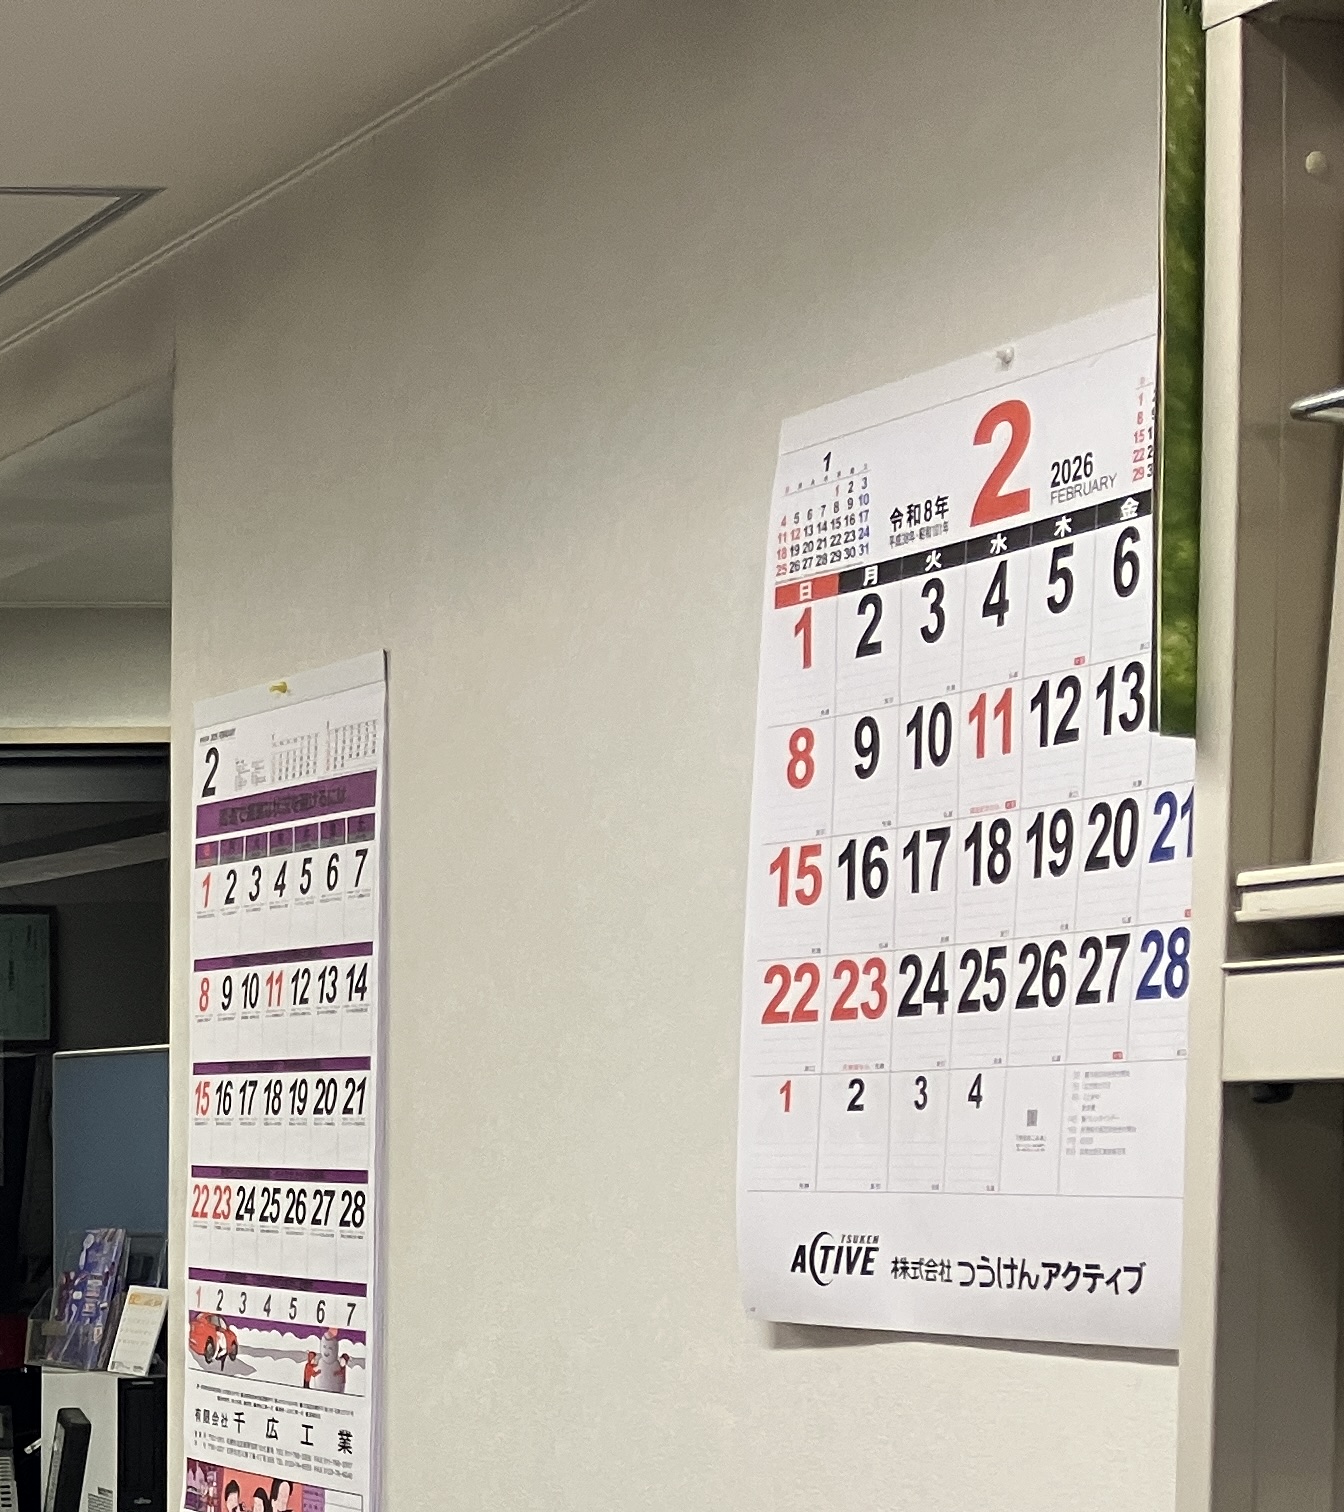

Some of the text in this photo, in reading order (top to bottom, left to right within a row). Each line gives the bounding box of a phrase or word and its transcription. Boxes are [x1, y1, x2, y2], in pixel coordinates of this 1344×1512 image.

[823, 451, 831, 472] 1
[969, 400, 1031, 527] 2
[1051, 452, 1093, 488] 2026
[889, 495, 949, 533] 令和8年
[1051, 473, 1117, 505] FEBRUARY
[864, 566, 879, 586] 月
[925, 550, 943, 571] 火
[989, 534, 1008, 554] 水
[1054, 516, 1073, 537] 木
[1120, 498, 1140, 519] 金
[794, 526, 1140, 669] 1 2 3 4 5 6
[787, 661, 1145, 789] 8 9 10 11 12 13
[201, 747, 219, 798] 2
[769, 785, 1194, 907] 15 16 17 18 19 20 21
[202, 848, 368, 908] 1 2 3 4 5 6 7
[761, 927, 1190, 1024] 22 23 24 25 26 27 28
[195, 1077, 367, 1116] 15 16 17 18 19 20 21
[780, 1073, 983, 1112] 1 2 3 4
[191, 1184, 366, 1228] 22 23 24 25 26 27 28
